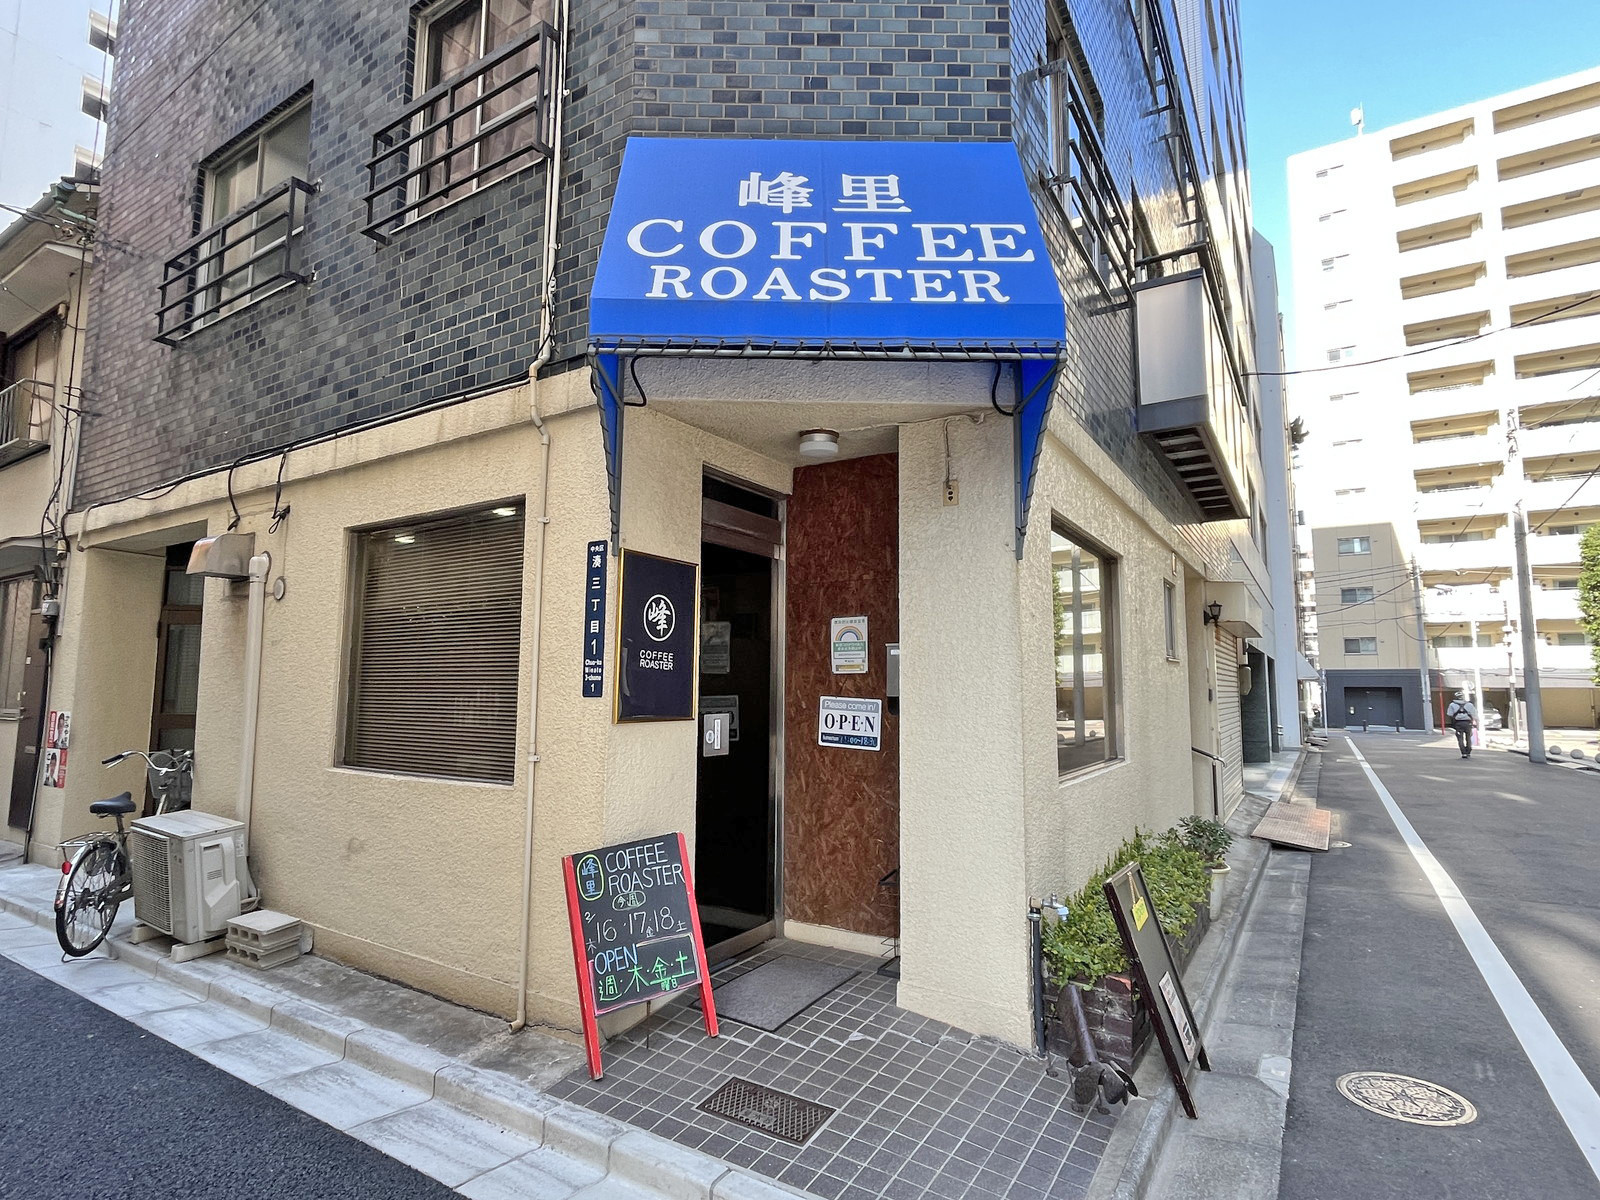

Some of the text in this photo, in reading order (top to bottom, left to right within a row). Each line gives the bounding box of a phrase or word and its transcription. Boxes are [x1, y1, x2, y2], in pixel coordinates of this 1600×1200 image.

[738, 171, 911, 214] 峰里
[626, 218, 1035, 262] COFFEE
[645, 265, 1011, 303] ROASTER
[648, 599, 671, 636] 峰
[639, 650, 674, 662] COFFEE
[639, 659, 674, 671] ROASTER
[590, 683, 595, 692] 1
[824, 700, 847, 709] Please
[847, 703, 867, 711] come
[605, 842, 668, 873] COFFEE
[581, 858, 601, 897] 峰里
[608, 863, 686, 896] ROASTER
[617, 892, 640, 907] 今週
[676, 920, 688, 932] 土
[594, 943, 638, 975] OPEN
